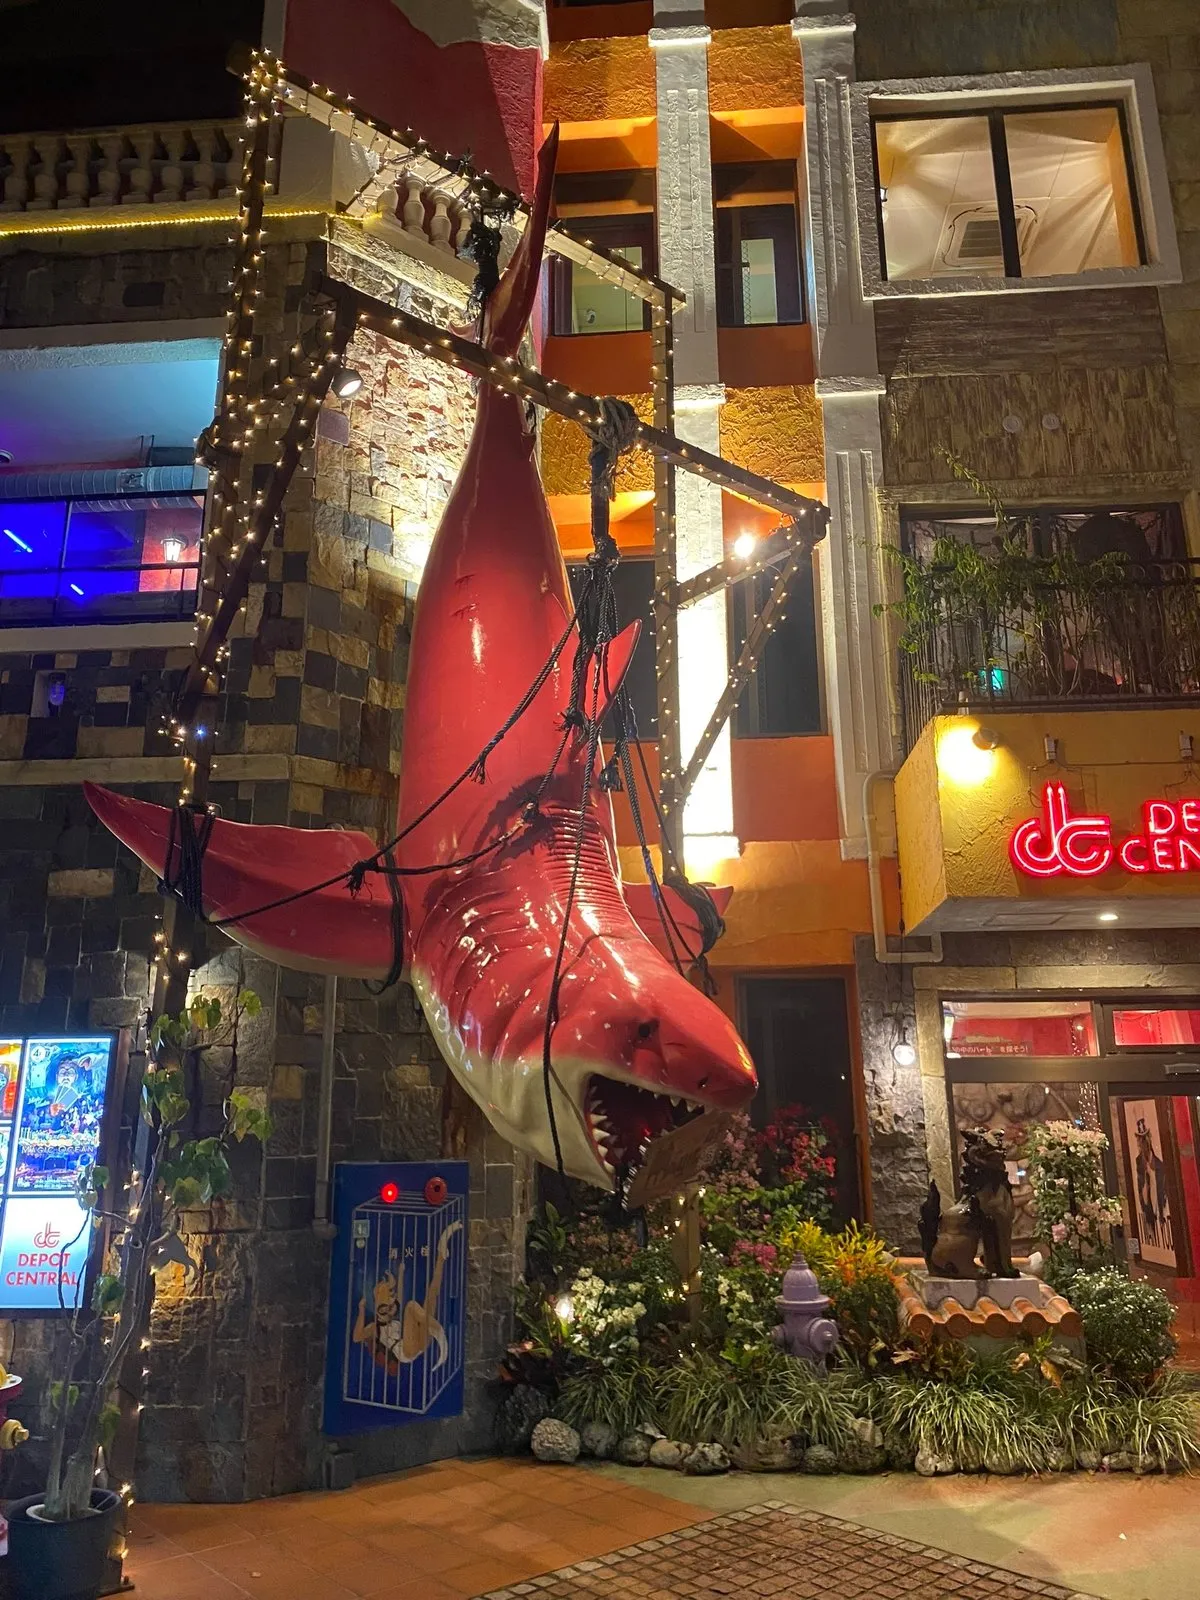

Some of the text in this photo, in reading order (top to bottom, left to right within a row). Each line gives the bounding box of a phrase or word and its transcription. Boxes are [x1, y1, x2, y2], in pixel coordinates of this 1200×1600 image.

[1145, 800, 1200, 834] DE
[21, 1146, 53, 1154] MAGIC
[18, 1252, 71, 1267] DEPOT
[6, 1271, 78, 1286] CENTRAL
